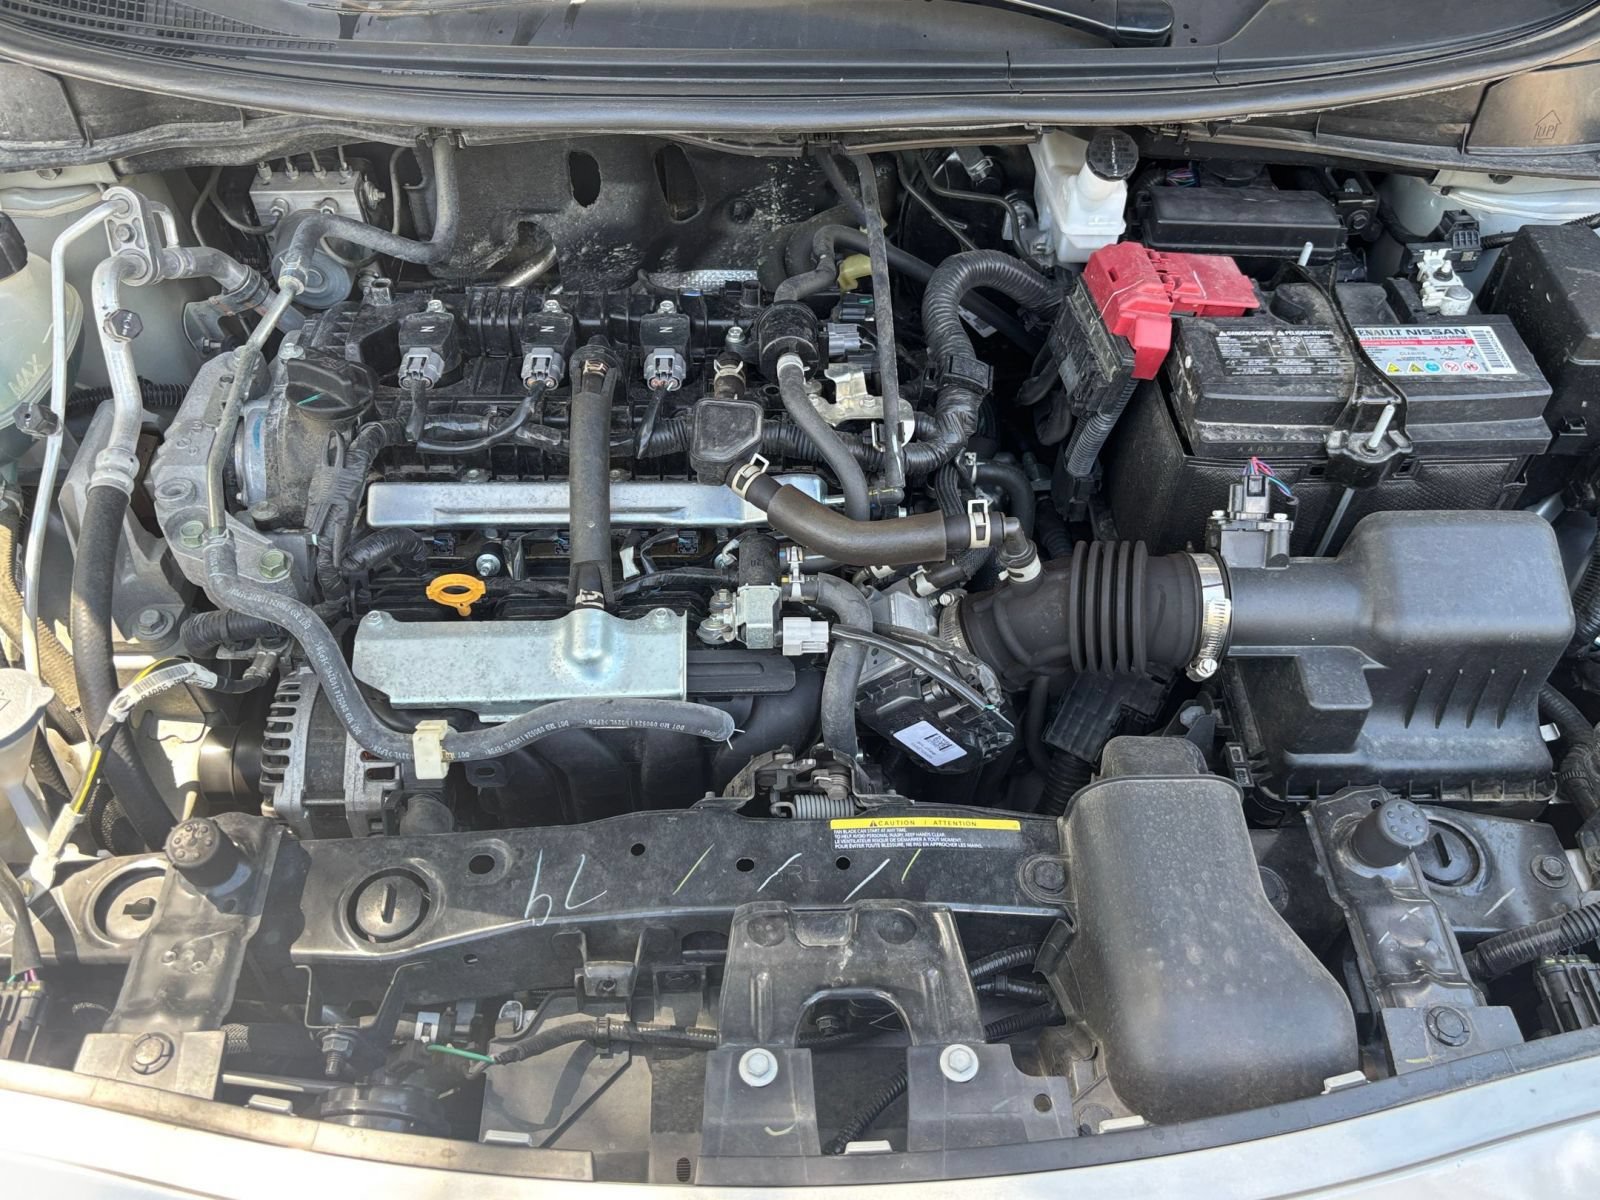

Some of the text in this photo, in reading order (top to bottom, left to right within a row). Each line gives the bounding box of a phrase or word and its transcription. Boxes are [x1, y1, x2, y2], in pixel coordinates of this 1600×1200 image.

[1357, 328, 1467, 336] ENAULT NISSAN
[8, 353, 42, 399] MAX
